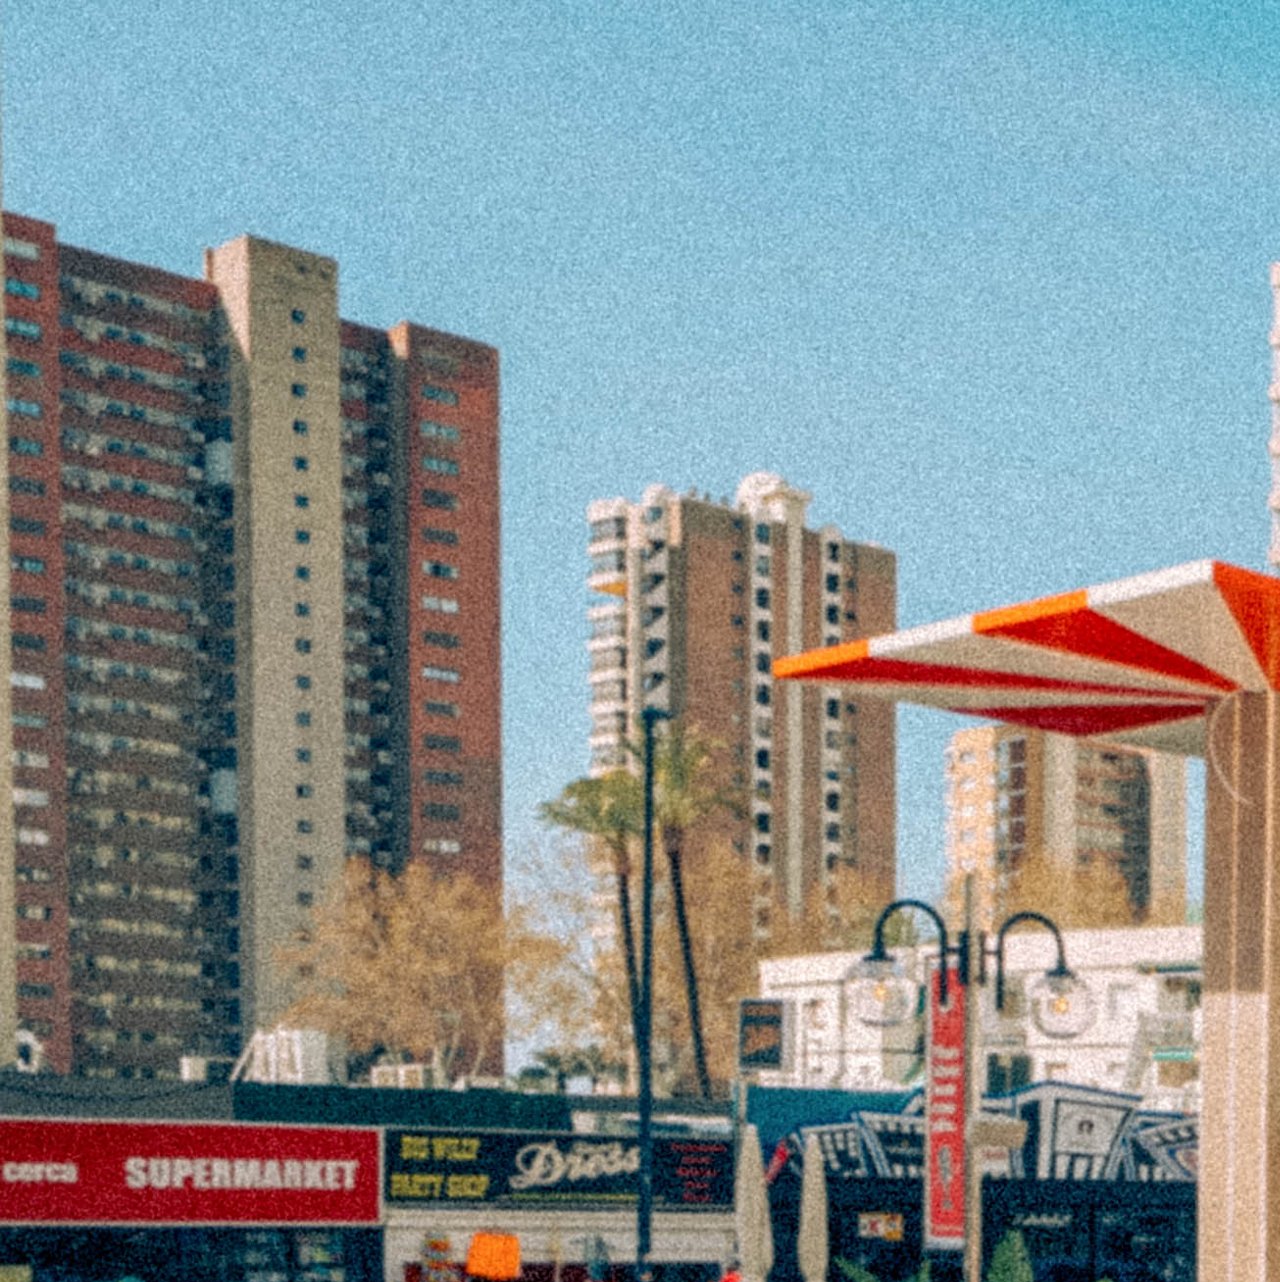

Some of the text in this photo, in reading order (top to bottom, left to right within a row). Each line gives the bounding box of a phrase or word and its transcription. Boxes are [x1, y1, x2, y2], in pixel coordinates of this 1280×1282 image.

[3, 1161, 77, 1183] cerca
[124, 1157, 358, 1191] SUPERMARKET
[508, 1140, 640, 1188] Dress
[391, 1173, 442, 1197] PARTY
[447, 1174, 490, 1198] SHOP
